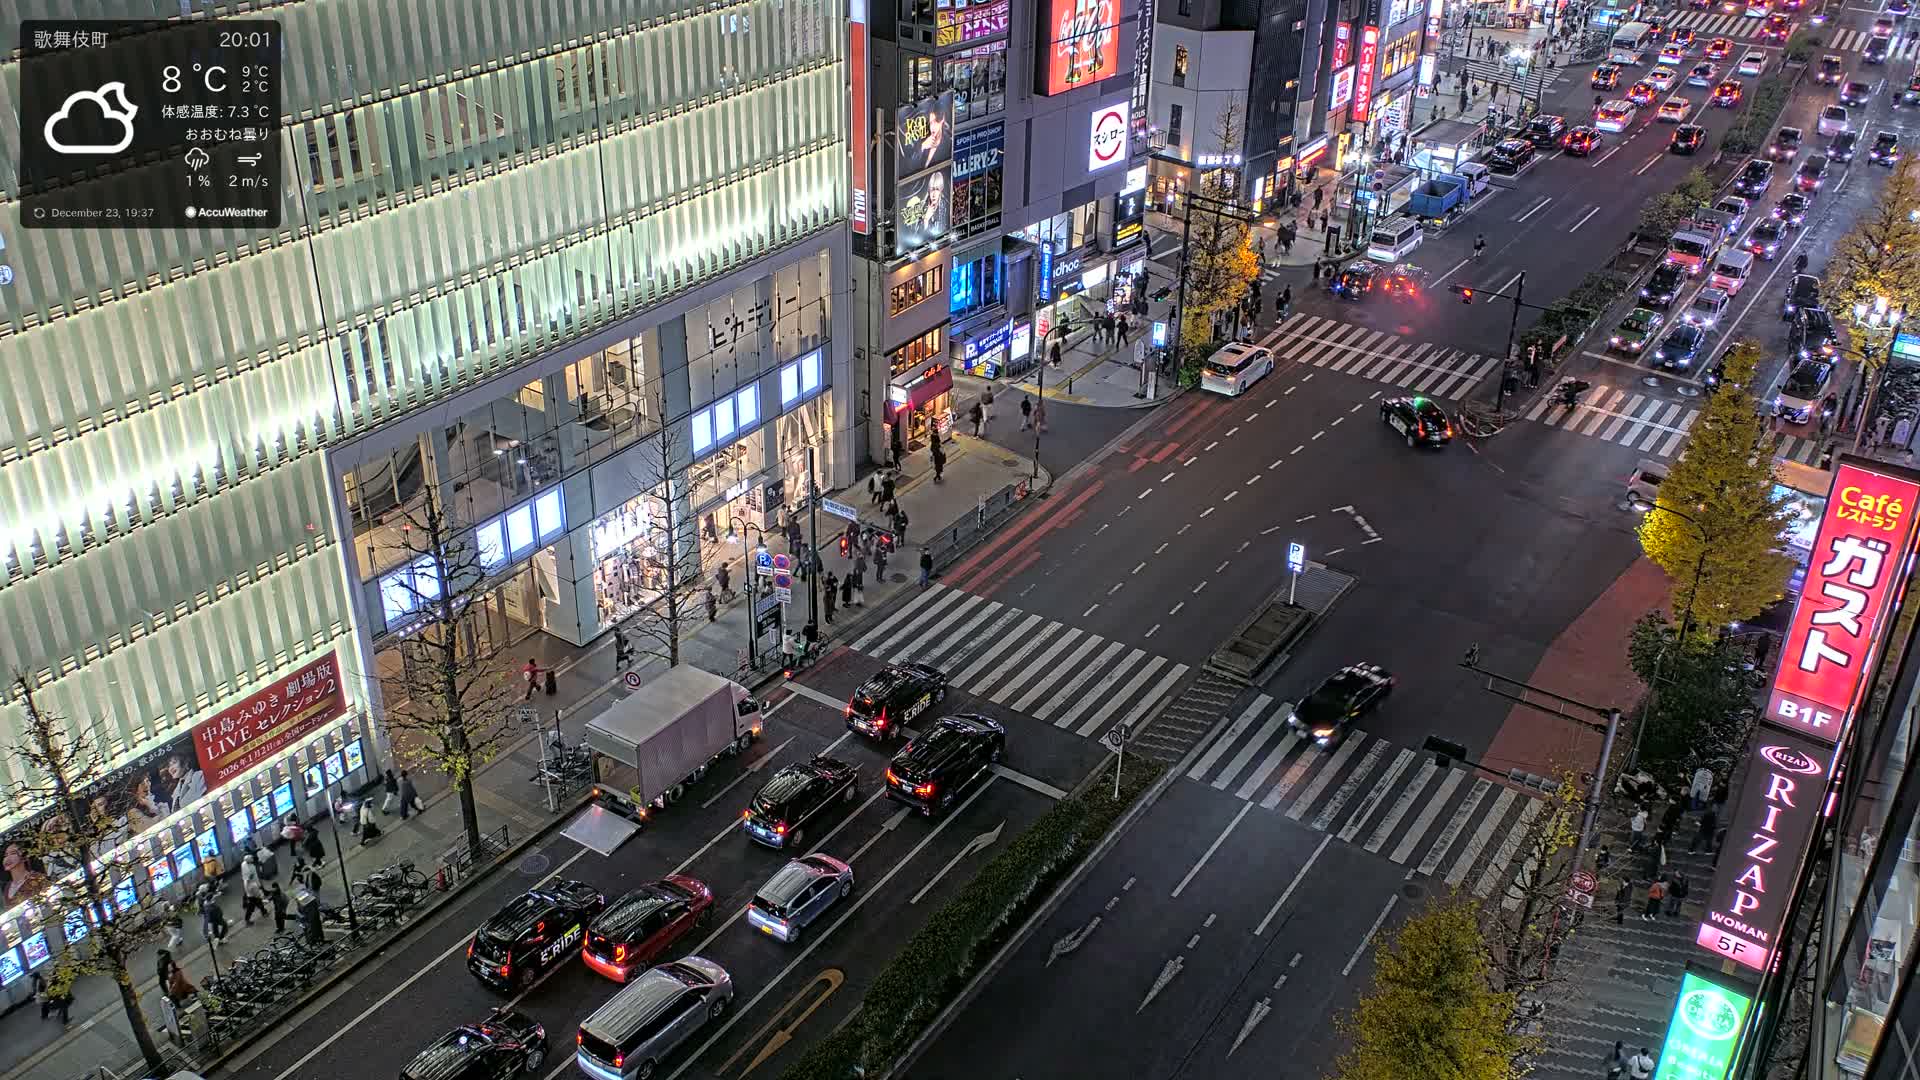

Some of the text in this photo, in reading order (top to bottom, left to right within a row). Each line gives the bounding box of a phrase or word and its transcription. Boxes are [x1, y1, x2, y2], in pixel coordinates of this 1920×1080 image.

[1357, 46, 1374, 112] バーガーキング
[956, 134, 976, 146] SPORTS
[988, 125, 1002, 137] SHOP
[1094, 128, 1125, 145] スシロー
[854, 188, 865, 222] MUJI
[970, 217, 999, 231] BASKETBALL
[712, 296, 797, 353] ピカデリー
[1836, 505, 1898, 531] レストラン
[1841, 486, 1903, 518] Café
[1292, 544, 1301, 553] P
[1799, 535, 1889, 673] ガスト
[202, 693, 279, 743] 中島みゆき
[286, 661, 333, 699] 劇場版
[1777, 699, 1832, 729] B1F
[206, 726, 253, 761] LIVE
[256, 679, 336, 731] セレクション2
[285, 708, 335, 741] 全国ロードショー
[1775, 751, 1808, 768] RIZAP
[1730, 773, 1796, 917] RIZAP
[1711, 911, 1768, 942] WOMAN
[541, 928, 581, 967] S.RIDE
[1717, 936, 1747, 956] 5F
